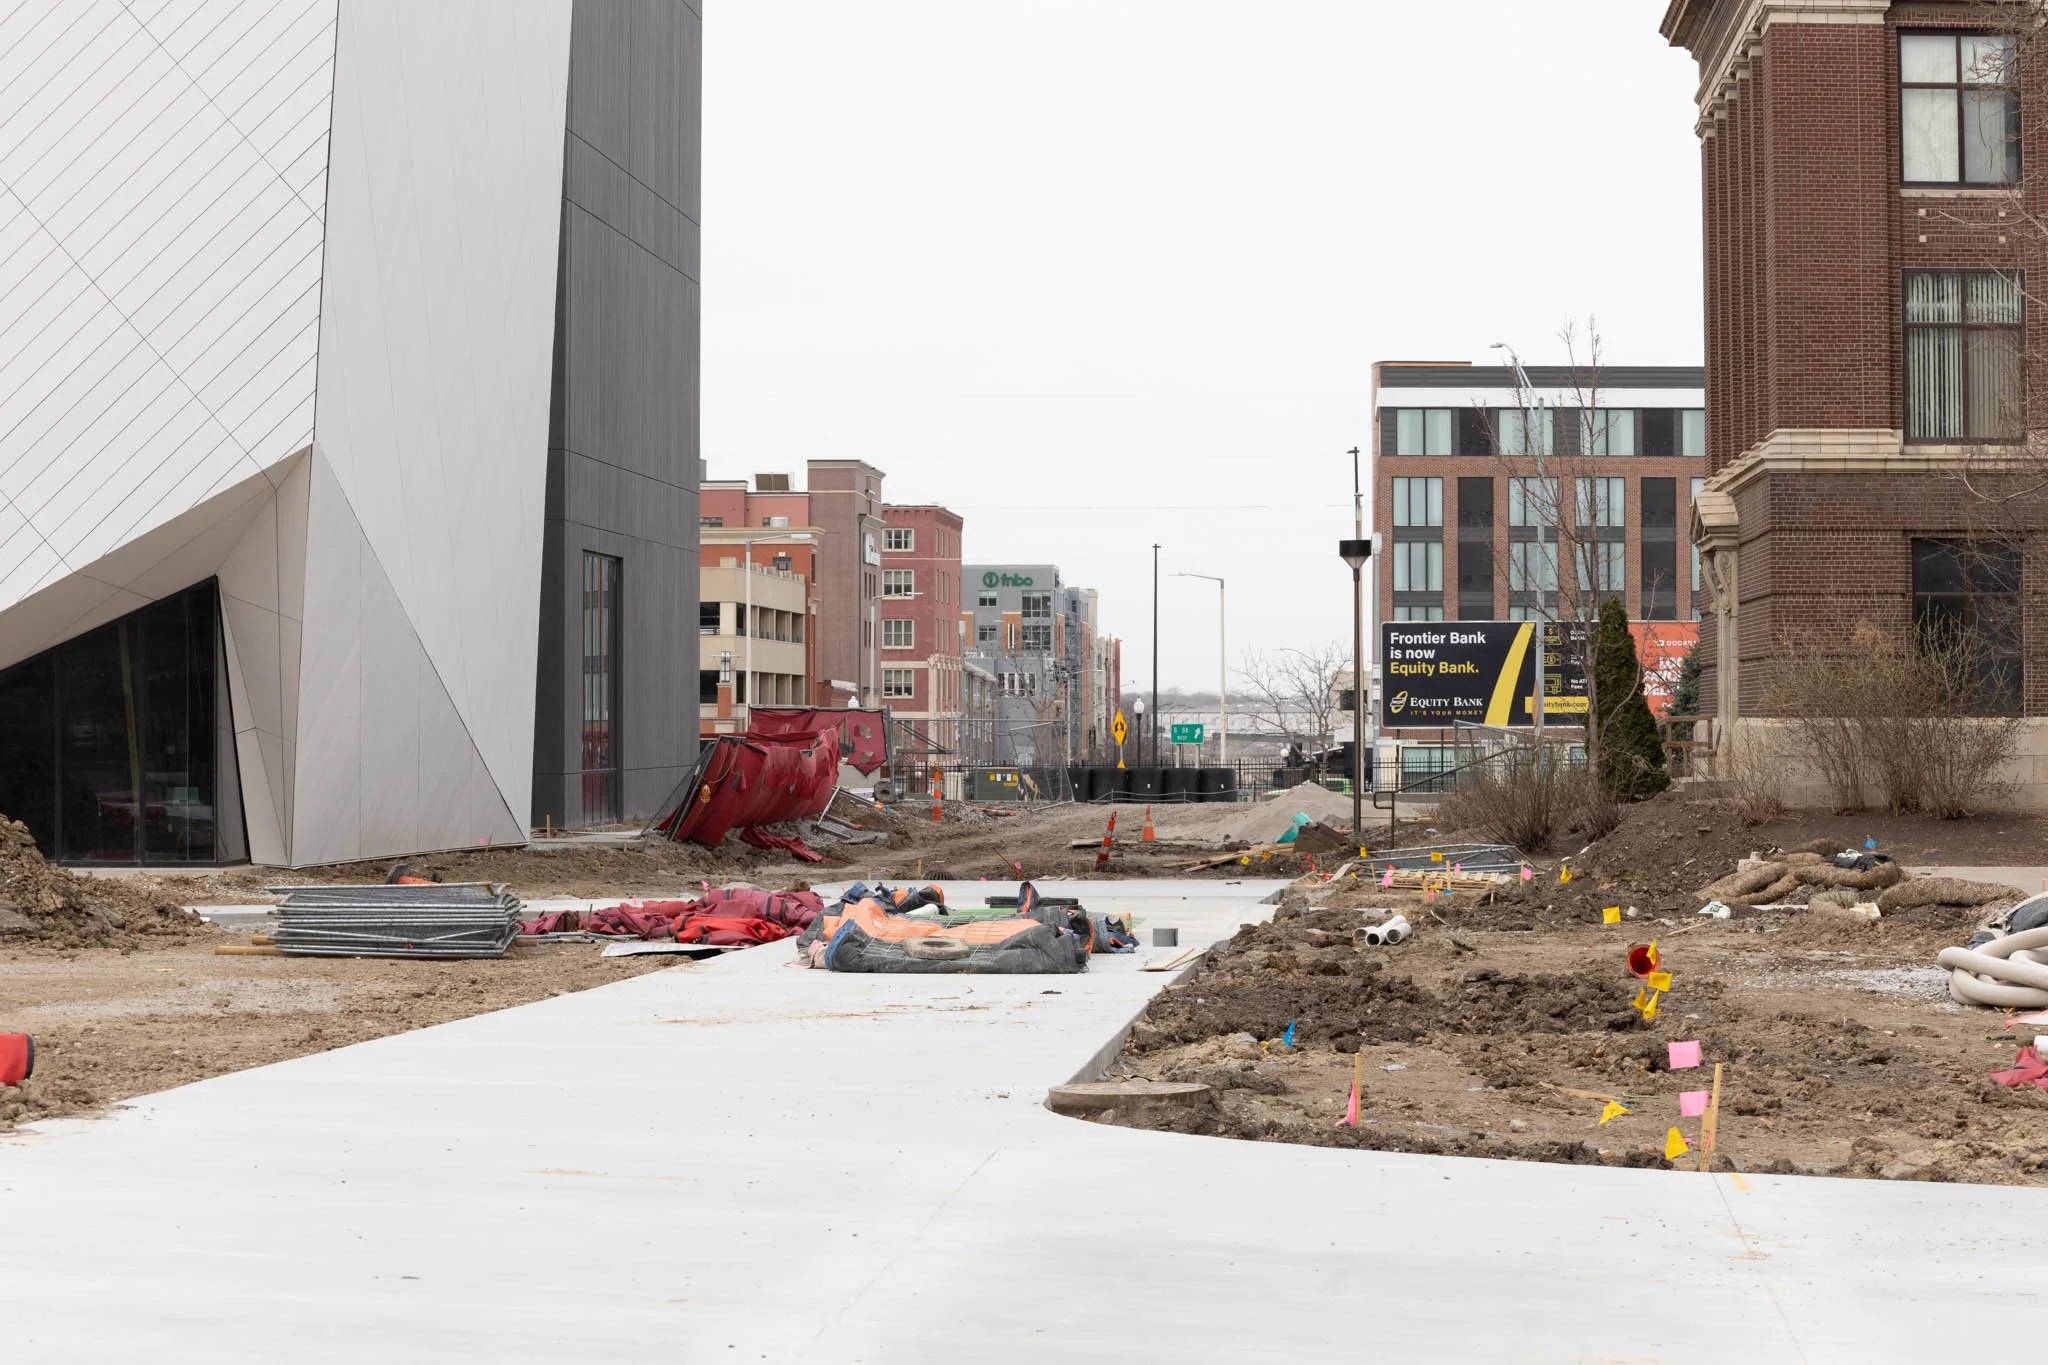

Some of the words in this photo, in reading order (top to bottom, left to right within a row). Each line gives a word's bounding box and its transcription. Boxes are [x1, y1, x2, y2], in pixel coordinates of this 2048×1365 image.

[1000, 573, 1033, 587] fnbo
[1390, 632, 1446, 645] Frontier
[1450, 631, 1486, 644] Bank
[1390, 647, 1402, 659] is
[1405, 649, 1436, 659] now
[1390, 661, 1435, 677] Equity
[1439, 660, 1479, 674] Bank.
[1410, 697, 1450, 708] EQUITY
[1453, 697, 1483, 707] BANK
